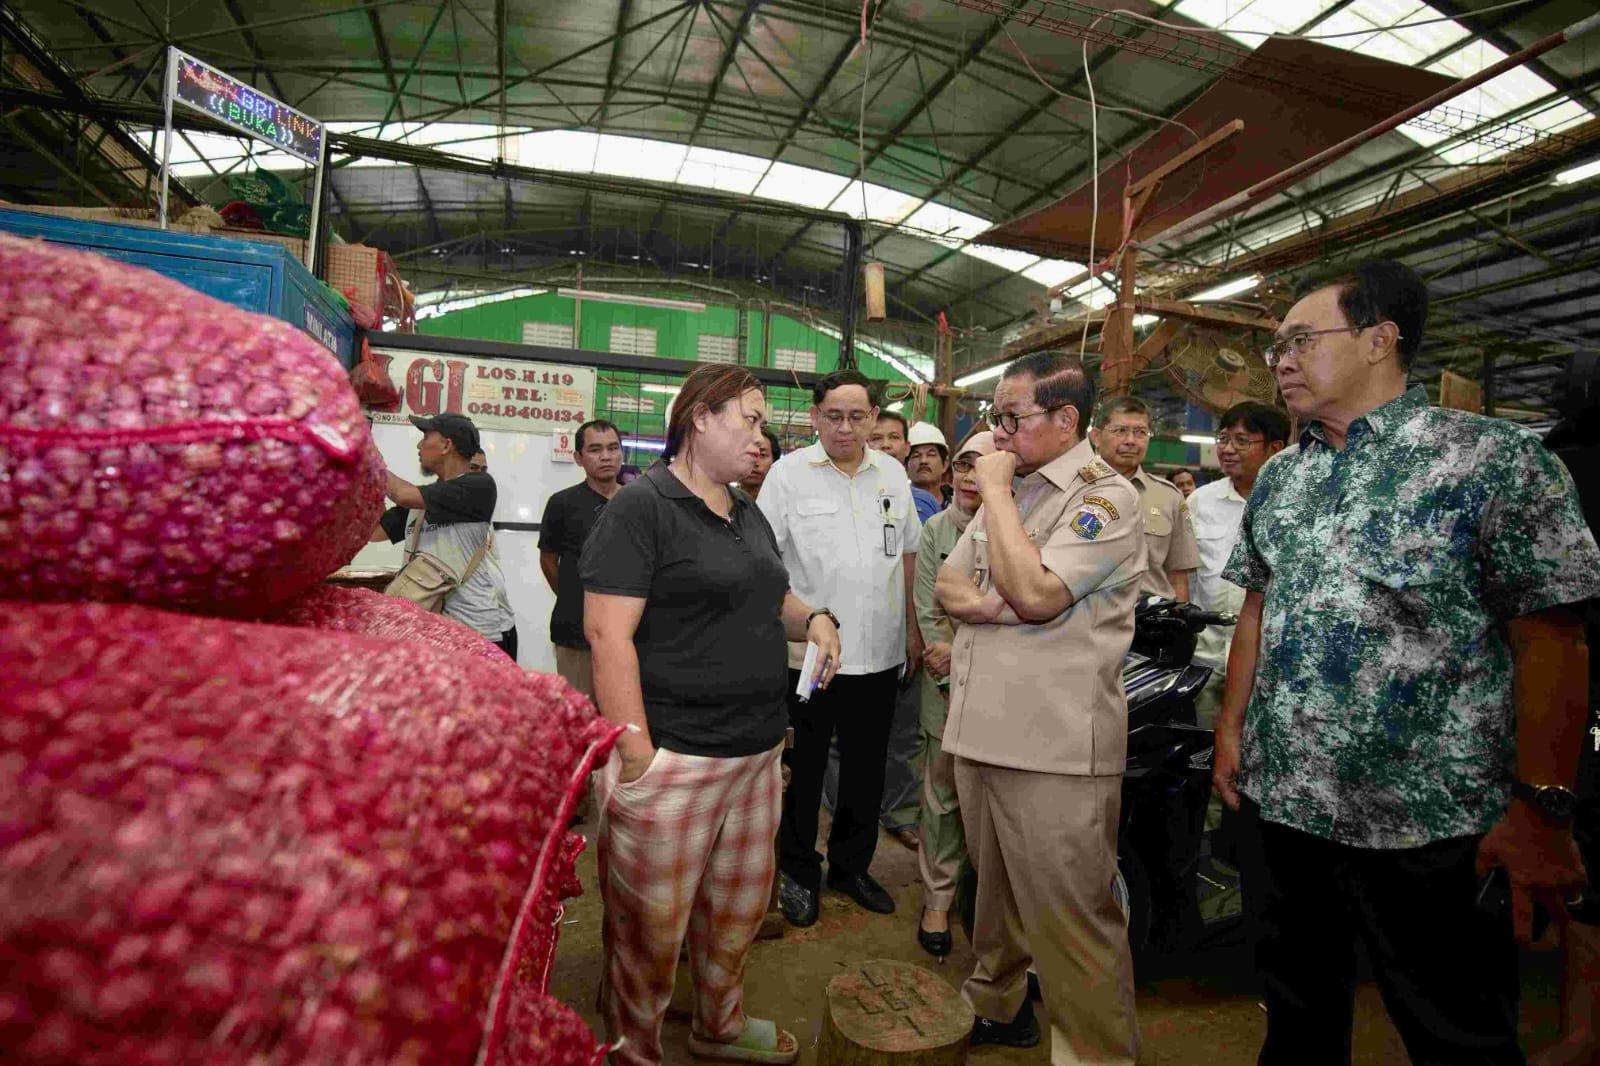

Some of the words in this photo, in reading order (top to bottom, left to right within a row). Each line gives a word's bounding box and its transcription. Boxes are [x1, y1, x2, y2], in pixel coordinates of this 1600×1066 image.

[241, 91, 272, 119] BRI
[277, 110, 316, 140] LINK
[502, 386, 547, 401] TEL:
[560, 435, 569, 449] 9
